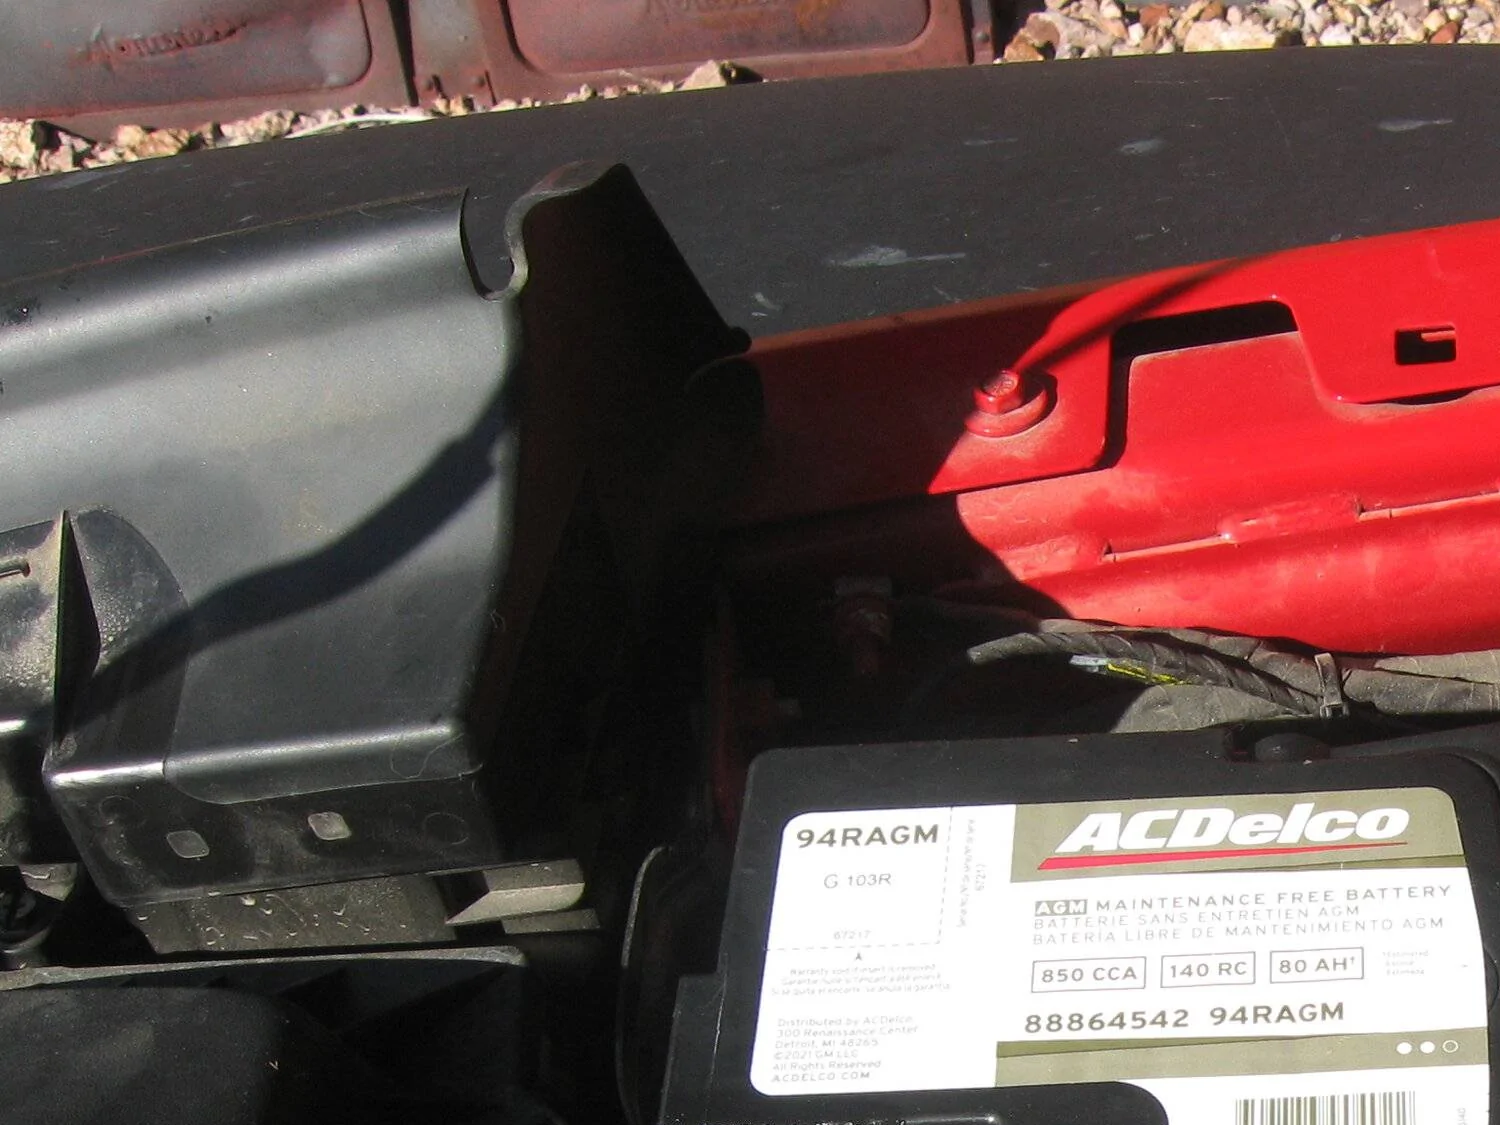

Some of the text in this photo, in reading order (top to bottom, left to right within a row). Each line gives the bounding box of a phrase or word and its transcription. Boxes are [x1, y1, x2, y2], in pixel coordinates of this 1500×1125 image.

[797, 824, 939, 848] 94RAGM
[1055, 802, 1411, 853] ACDelco
[824, 873, 892, 888] G 103R
[1035, 884, 1452, 917] AGM MAINTENANCE FREE BATTERY
[1034, 904, 1361, 930] BATTERIE SANS ENTRETIEN AGM
[1125, 927, 1181, 941] LIBRE
[1191, 926, 1215, 939] DE
[1225, 919, 1393, 938] MANTENIMIENTO
[1403, 916, 1444, 931] AGM
[1041, 966, 1137, 983] 850 CCA
[1169, 961, 1247, 978] 140 RC
[1280, 959, 1307, 974] 80
[1025, 1002, 1344, 1034] 88864542 94RAGM
